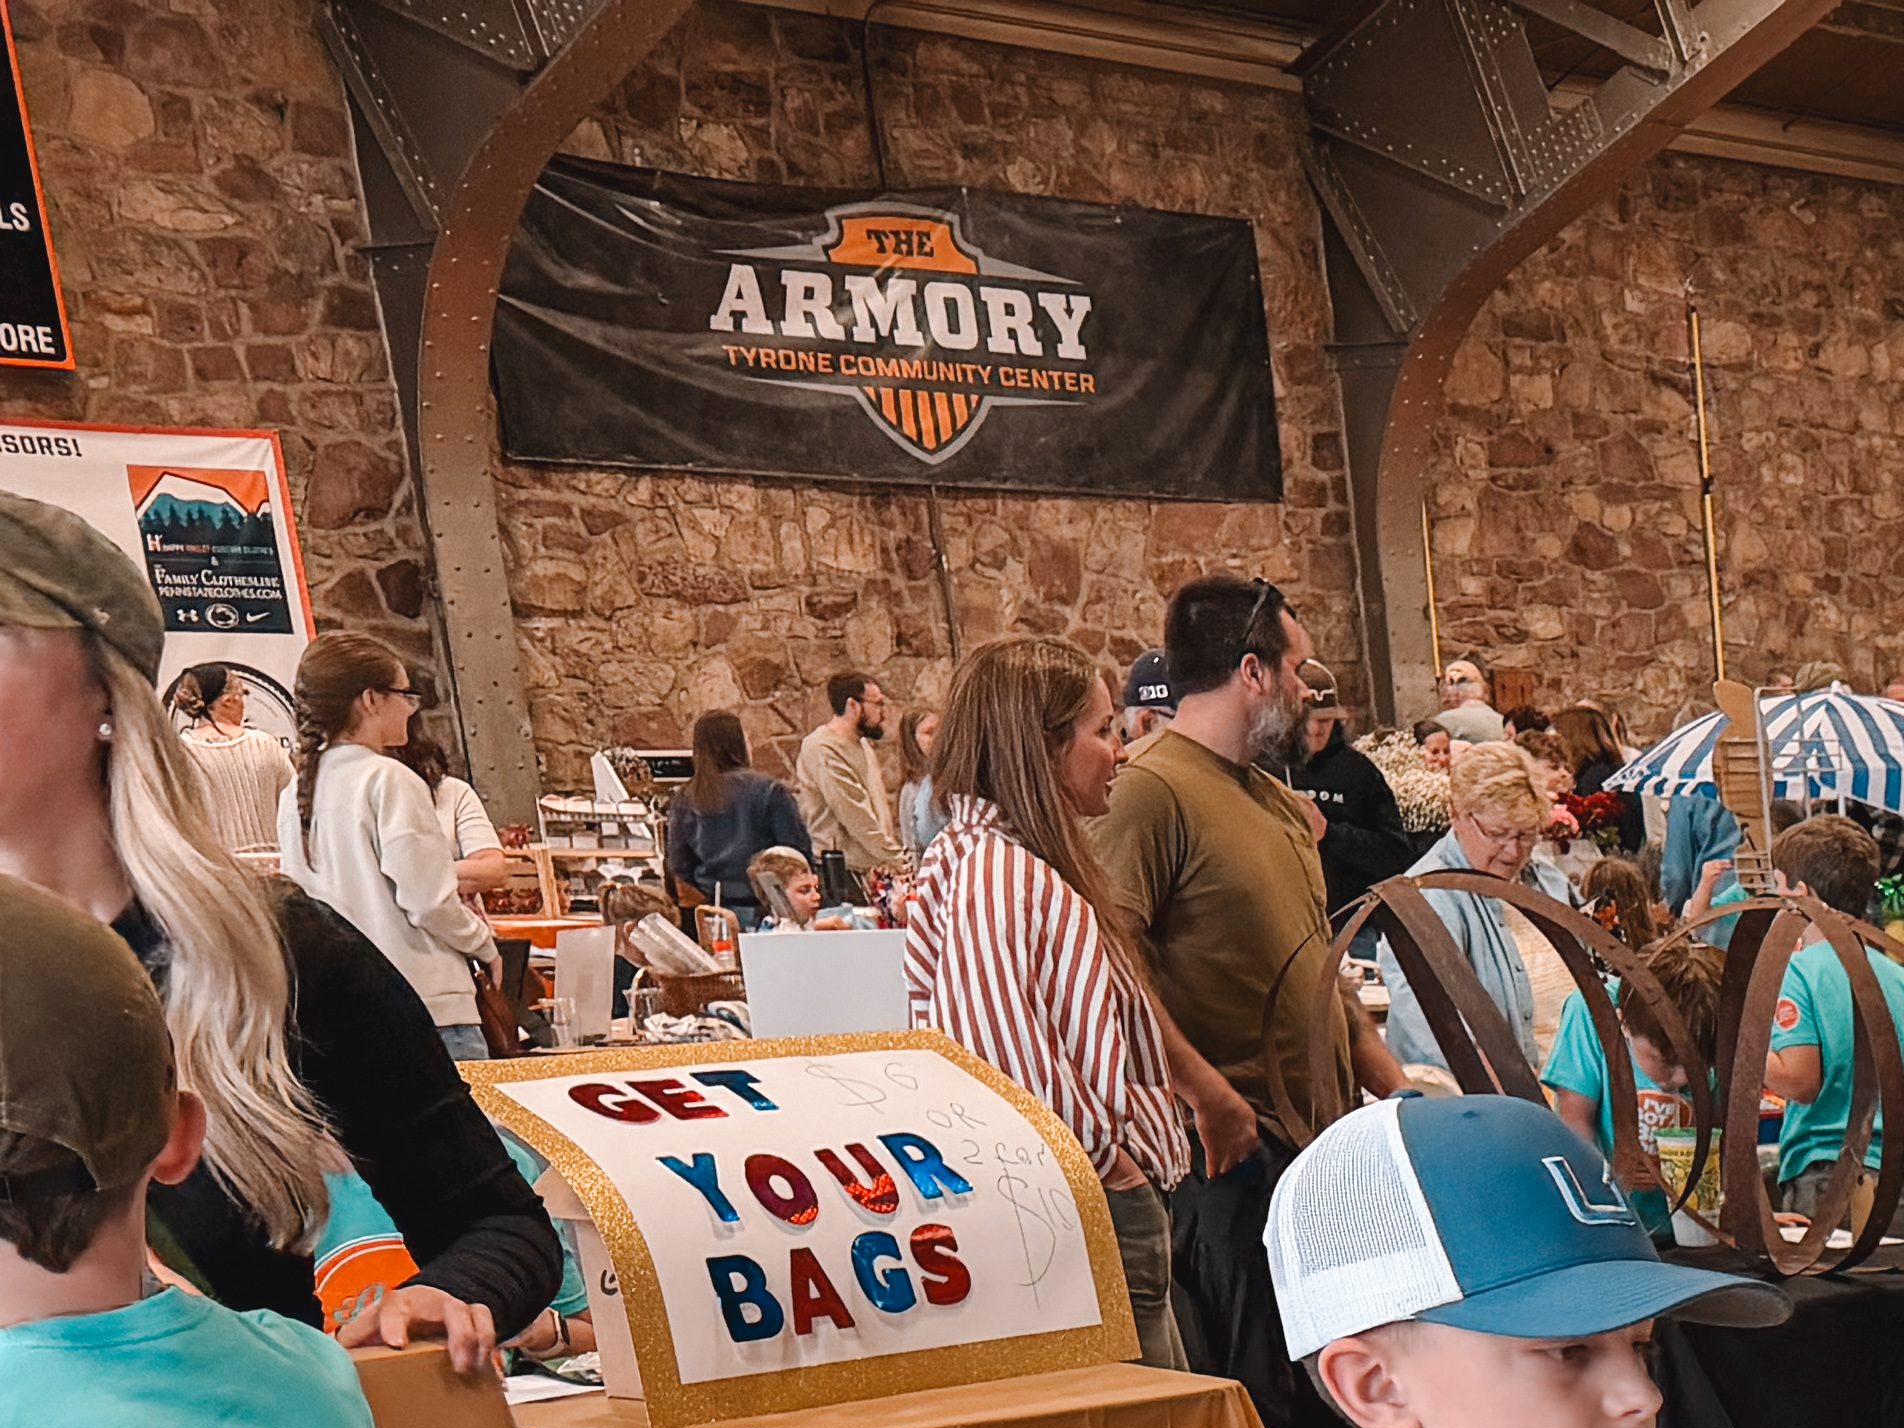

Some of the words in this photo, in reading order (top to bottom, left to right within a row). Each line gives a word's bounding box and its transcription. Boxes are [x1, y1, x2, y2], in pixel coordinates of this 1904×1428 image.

[866, 229, 935, 258] THE
[709, 263, 1093, 361] ARMORY
[721, 344, 834, 375] TYRONE
[839, 354, 992, 385] COMMUNITY
[998, 366, 1096, 394] CENTER
[154, 567, 199, 586] FAMILY
[567, 1069, 780, 1124] GET
[926, 1101, 987, 1129] OR
[656, 1132, 974, 1226] YOUR
[705, 1223, 972, 1343] BAGS
